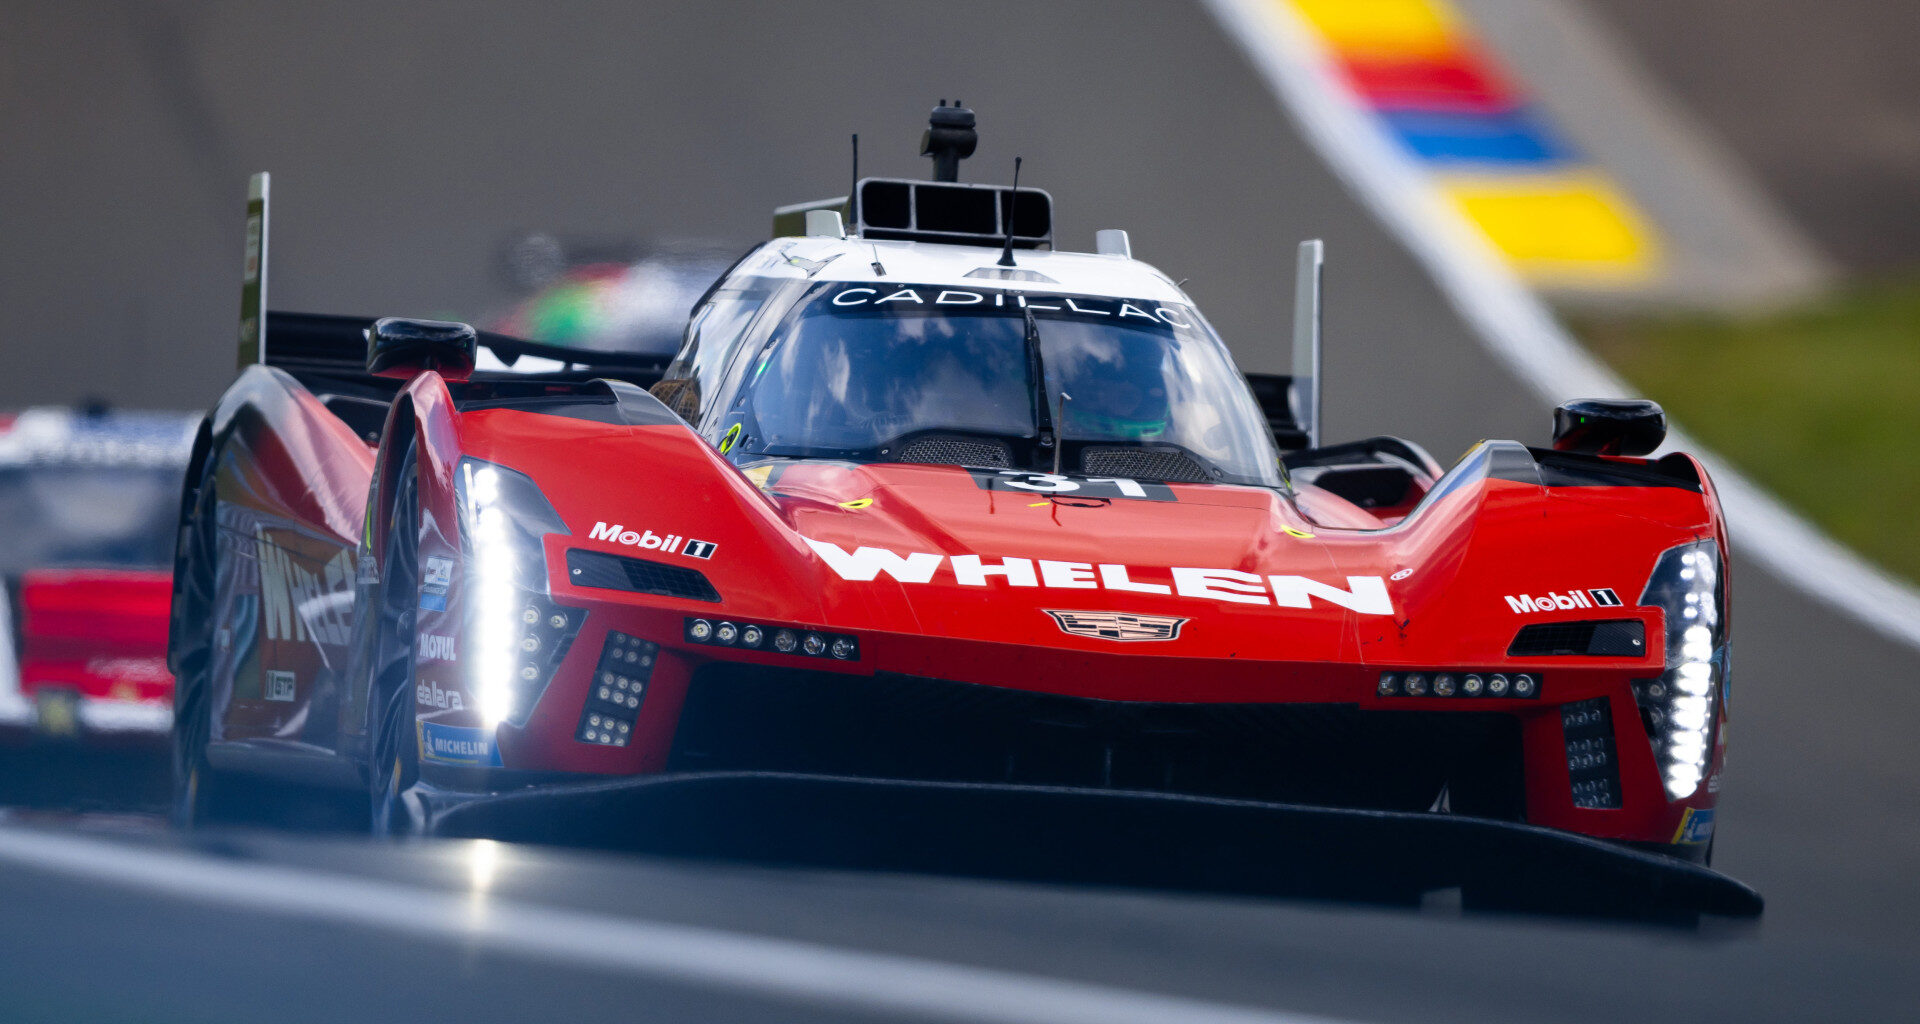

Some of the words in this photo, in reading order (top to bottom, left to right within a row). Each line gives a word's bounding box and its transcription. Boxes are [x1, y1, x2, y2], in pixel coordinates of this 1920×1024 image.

[832, 288, 1191, 329] CADILLAC
[999, 471, 1147, 498] 31
[588, 521, 682, 553] Mobil
[800, 535, 1395, 615] WHELEN
[1504, 589, 1593, 614] Mobil
[420, 633, 457, 661] MOTUL
[435, 738, 488, 756] MICHELIN
